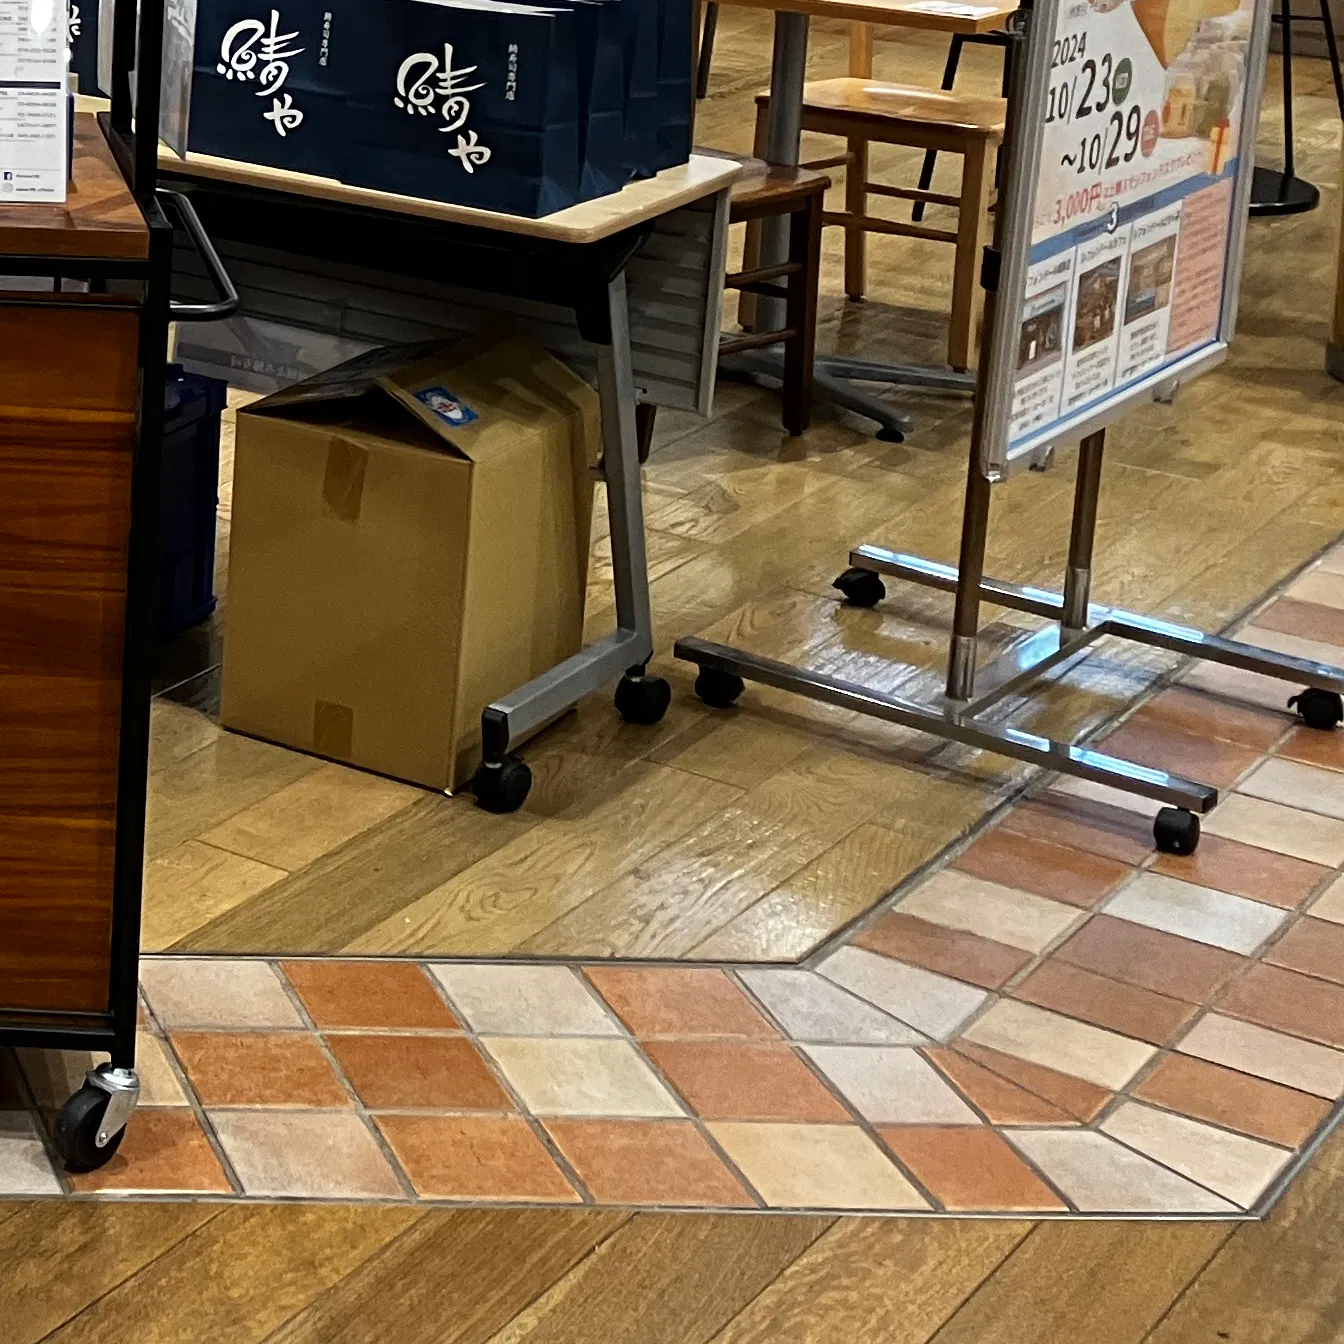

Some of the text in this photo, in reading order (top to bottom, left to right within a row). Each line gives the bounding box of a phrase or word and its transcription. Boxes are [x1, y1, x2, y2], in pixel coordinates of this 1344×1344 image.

[217, 9, 306, 137] 鯖や
[1045, 53, 1113, 125] 10/23
[1051, 31, 1087, 69] 2024
[393, 43, 488, 174] 鯖や
